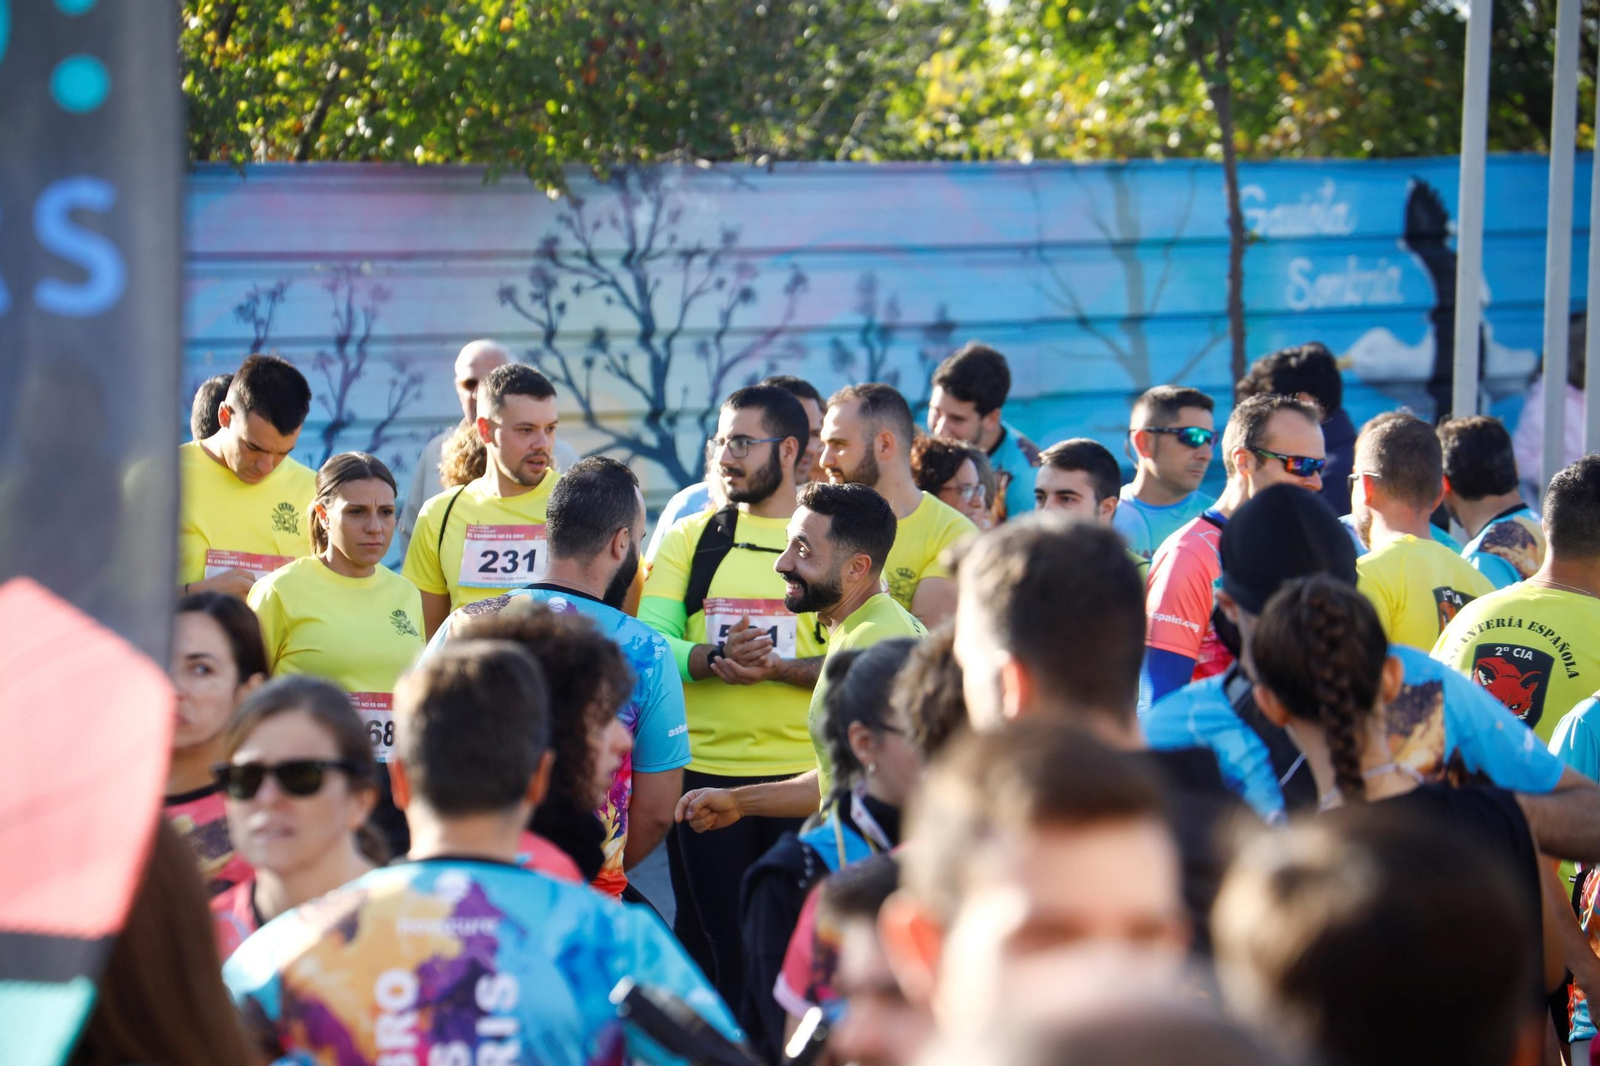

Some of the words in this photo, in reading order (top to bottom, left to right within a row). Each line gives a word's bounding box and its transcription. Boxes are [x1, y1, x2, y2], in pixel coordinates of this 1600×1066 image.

[0, 172, 128, 319] S
[478, 549, 536, 574] 231
[718, 624, 778, 648] 51
[1512, 648, 1533, 661] CIA
[1526, 621, 1580, 680] ESPAÑOLA
